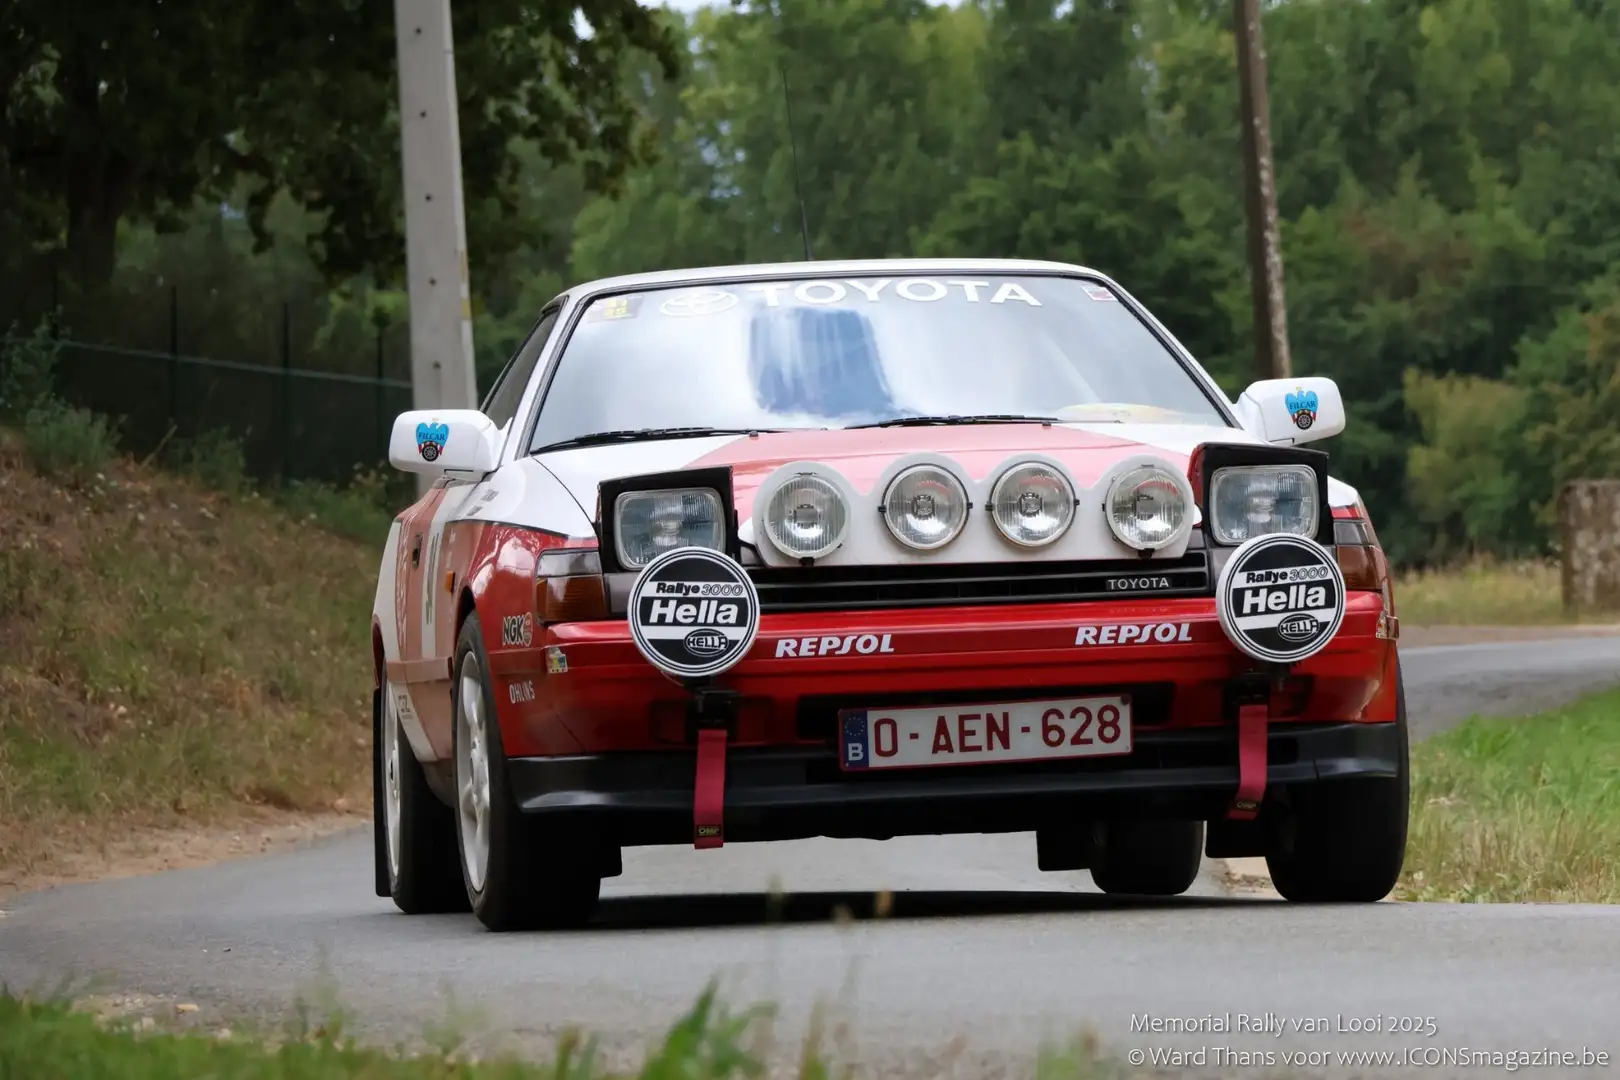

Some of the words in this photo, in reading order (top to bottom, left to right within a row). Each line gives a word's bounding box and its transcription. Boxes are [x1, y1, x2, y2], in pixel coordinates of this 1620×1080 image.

[750, 278, 1043, 308] TOYOTA
[1289, 400, 1316, 410] FILCAR
[418, 431, 446, 441] FILCAR
[1107, 576, 1169, 590] TOYOTA
[1246, 570, 1288, 584] Rallye
[1288, 566, 1329, 582] 3000
[656, 582, 700, 596] Rallye
[701, 583, 743, 597] 3000
[1242, 584, 1326, 614] Hella
[649, 599, 739, 625] Hella
[502, 614, 525, 647] NGK
[1074, 622, 1193, 646] REPSOL
[1280, 618, 1319, 634] HELLA
[687, 635, 728, 651] HELLA
[775, 633, 895, 658] REPSOL
[848, 743, 864, 763] B
